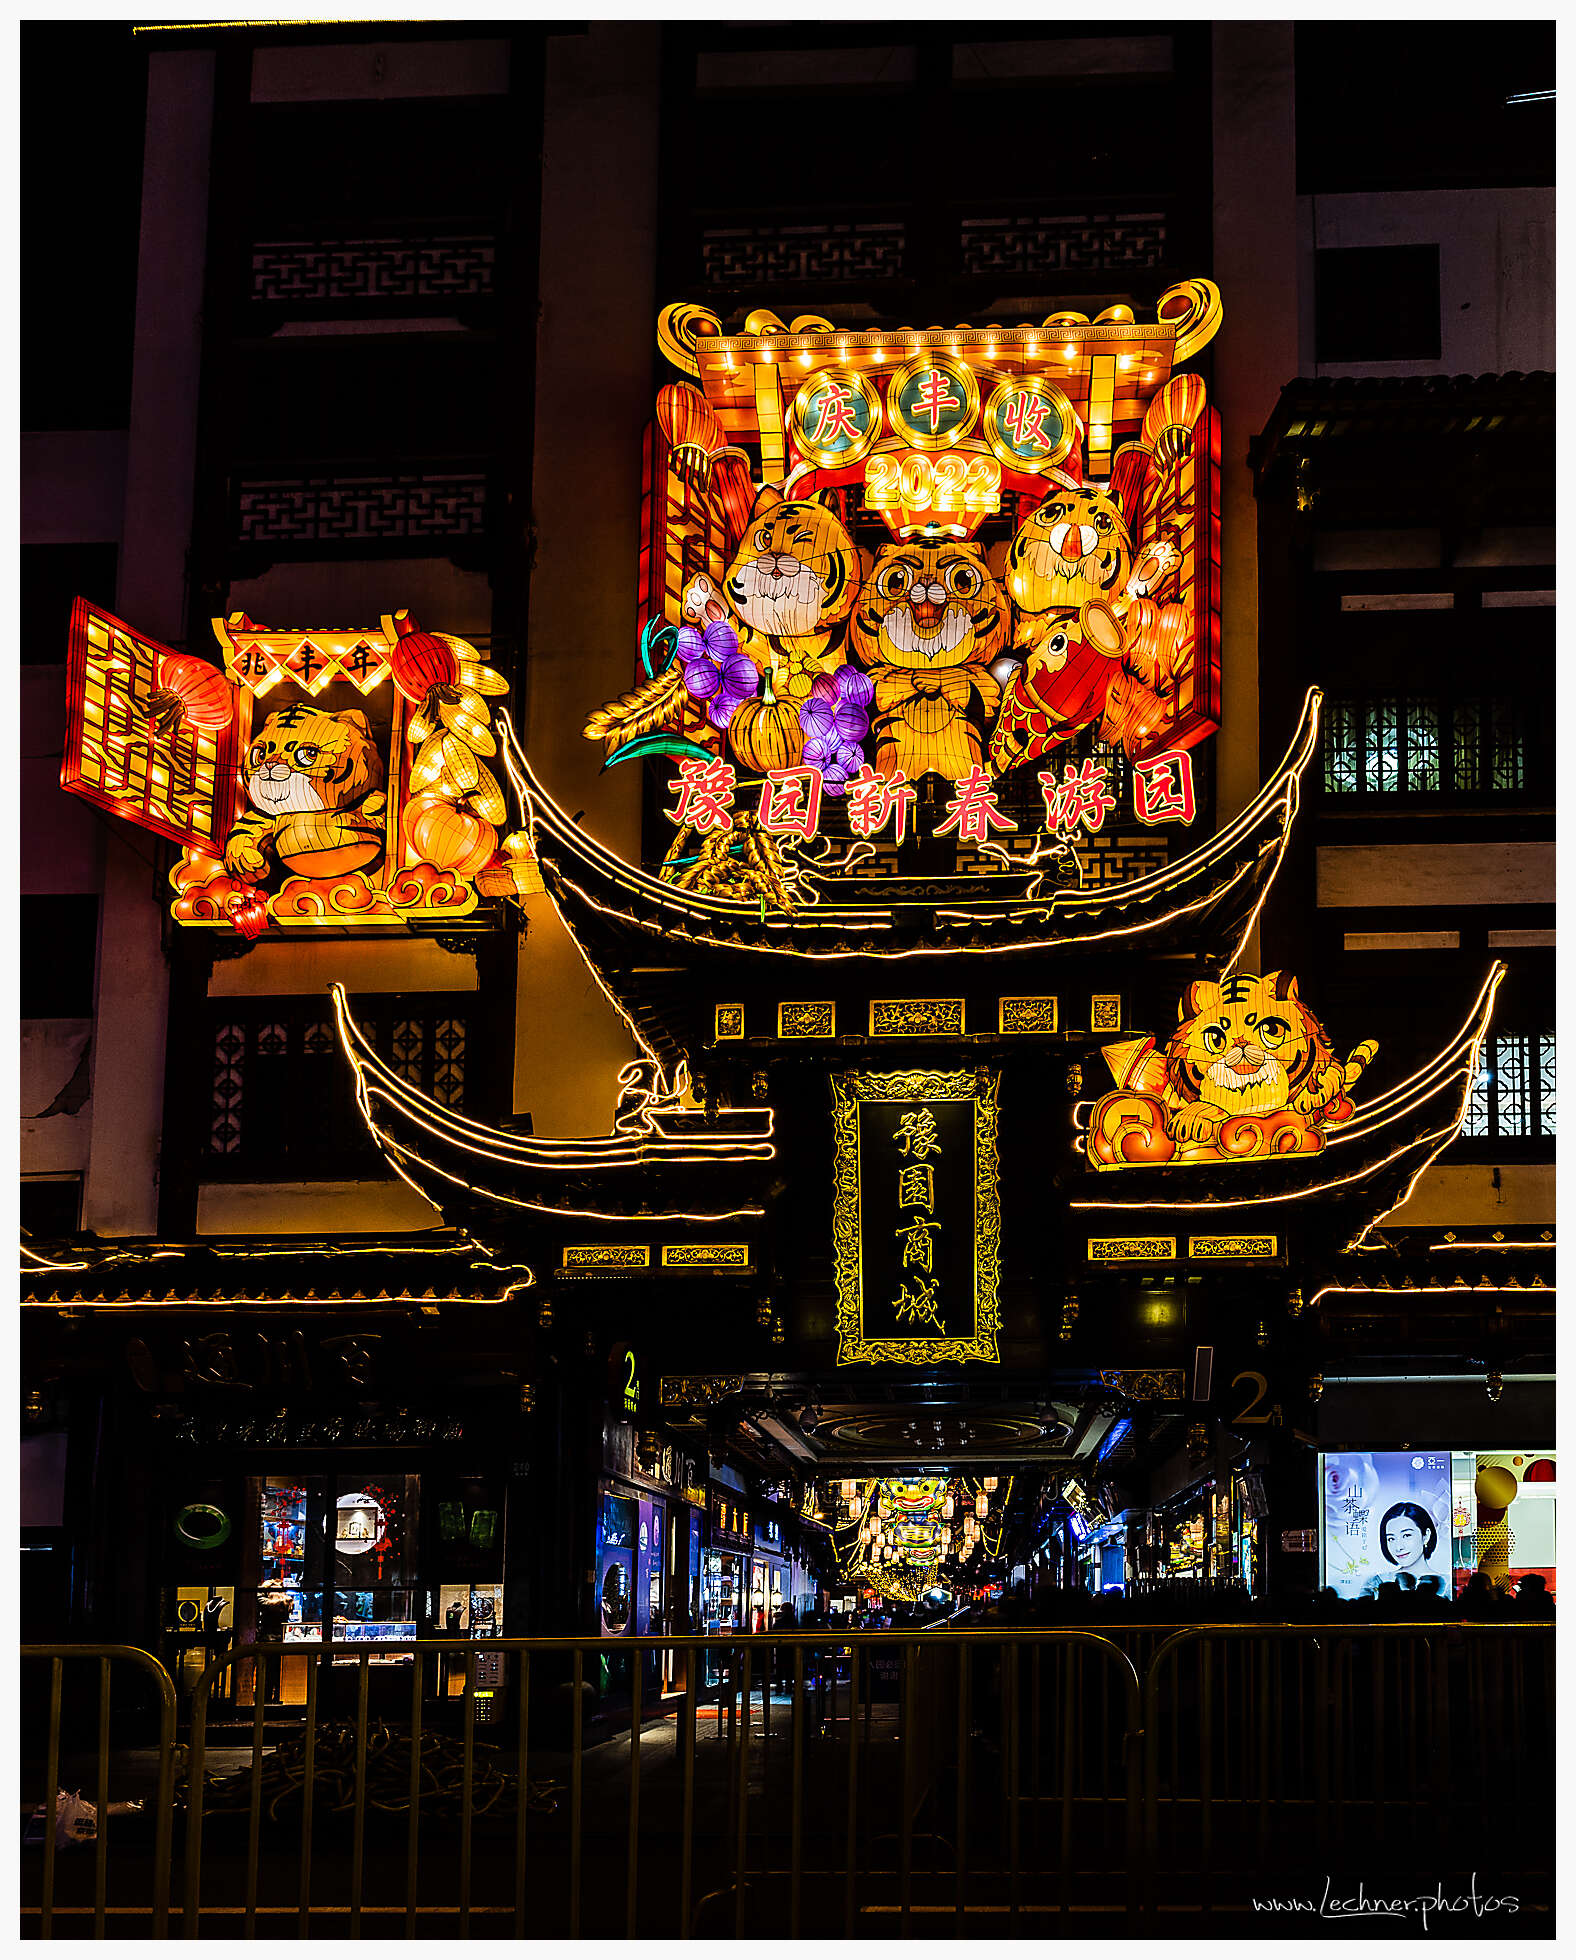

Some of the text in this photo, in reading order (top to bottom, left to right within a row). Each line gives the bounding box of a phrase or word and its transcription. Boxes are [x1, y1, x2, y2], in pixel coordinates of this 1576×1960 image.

[811, 369, 1051, 449] 庆丰收
[864, 454, 1002, 513] 2022
[663, 749, 1200, 845] 豫园新春游园
